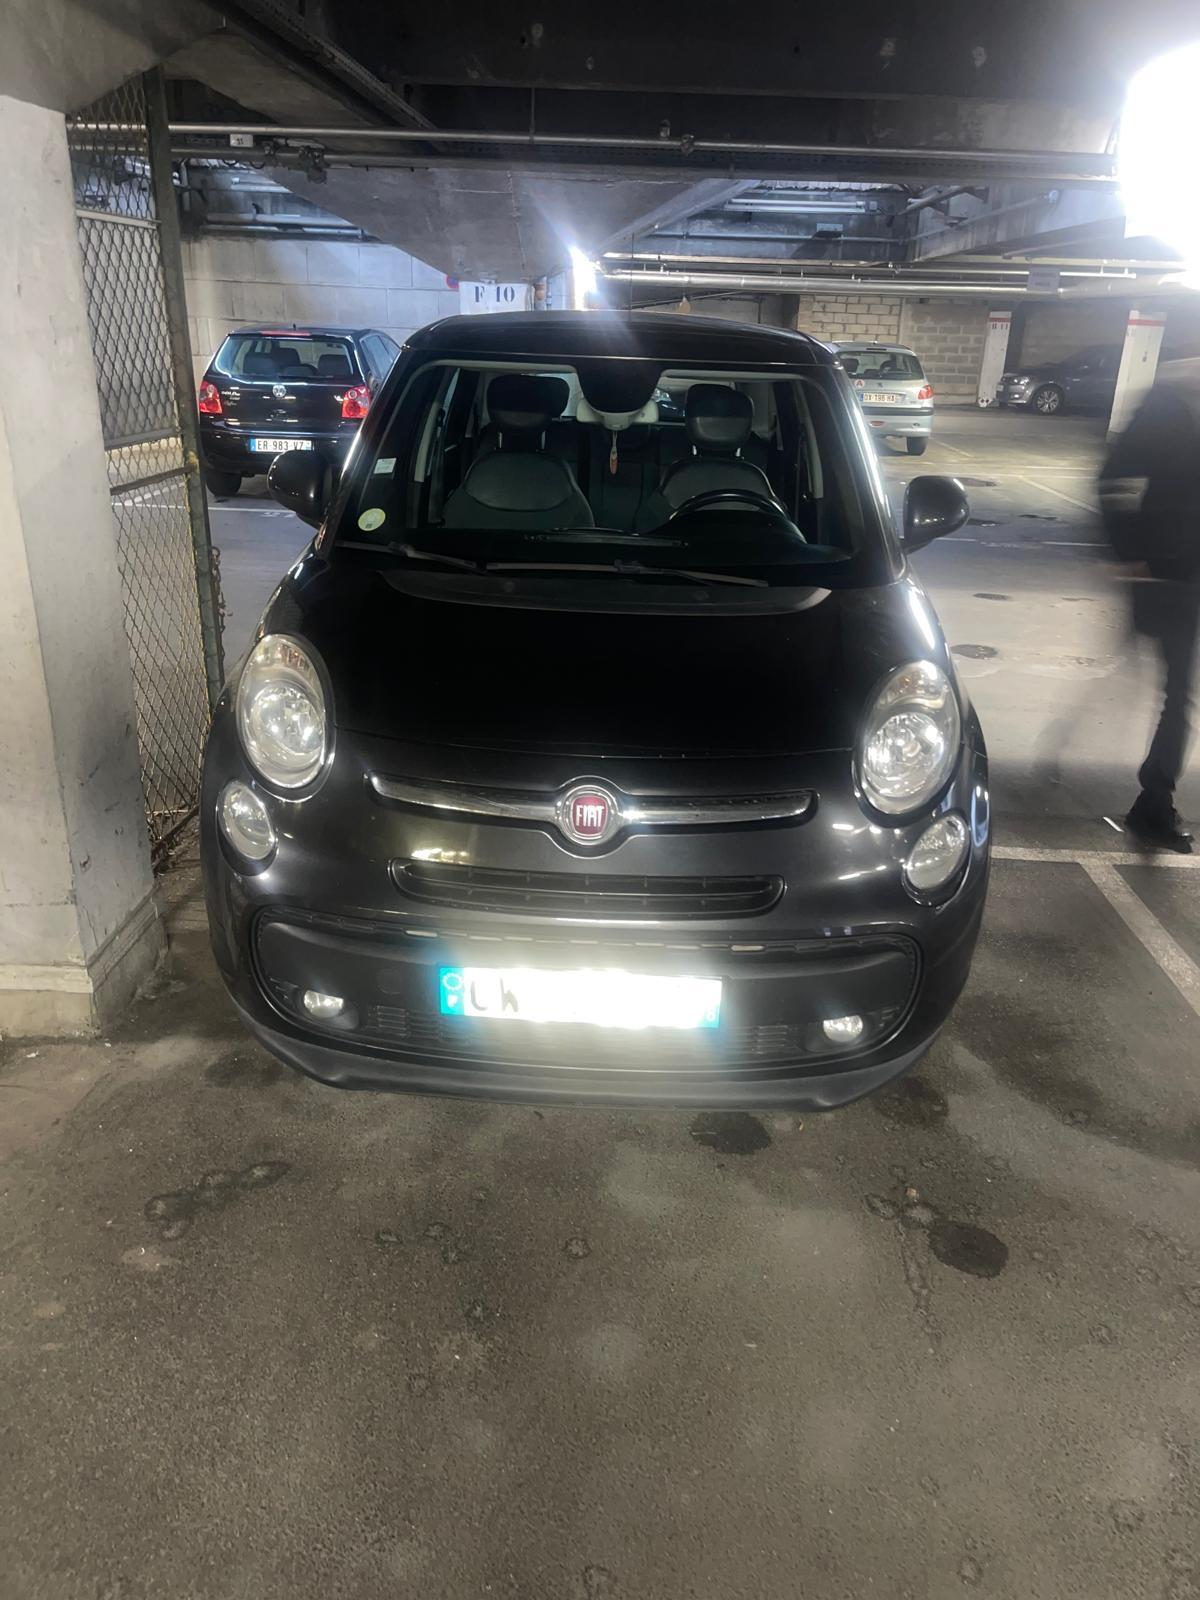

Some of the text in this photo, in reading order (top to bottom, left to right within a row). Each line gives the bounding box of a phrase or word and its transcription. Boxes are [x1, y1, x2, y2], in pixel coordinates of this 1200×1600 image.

[475, 286, 515, 302] F 10
[576, 804, 605, 827] FIAT
